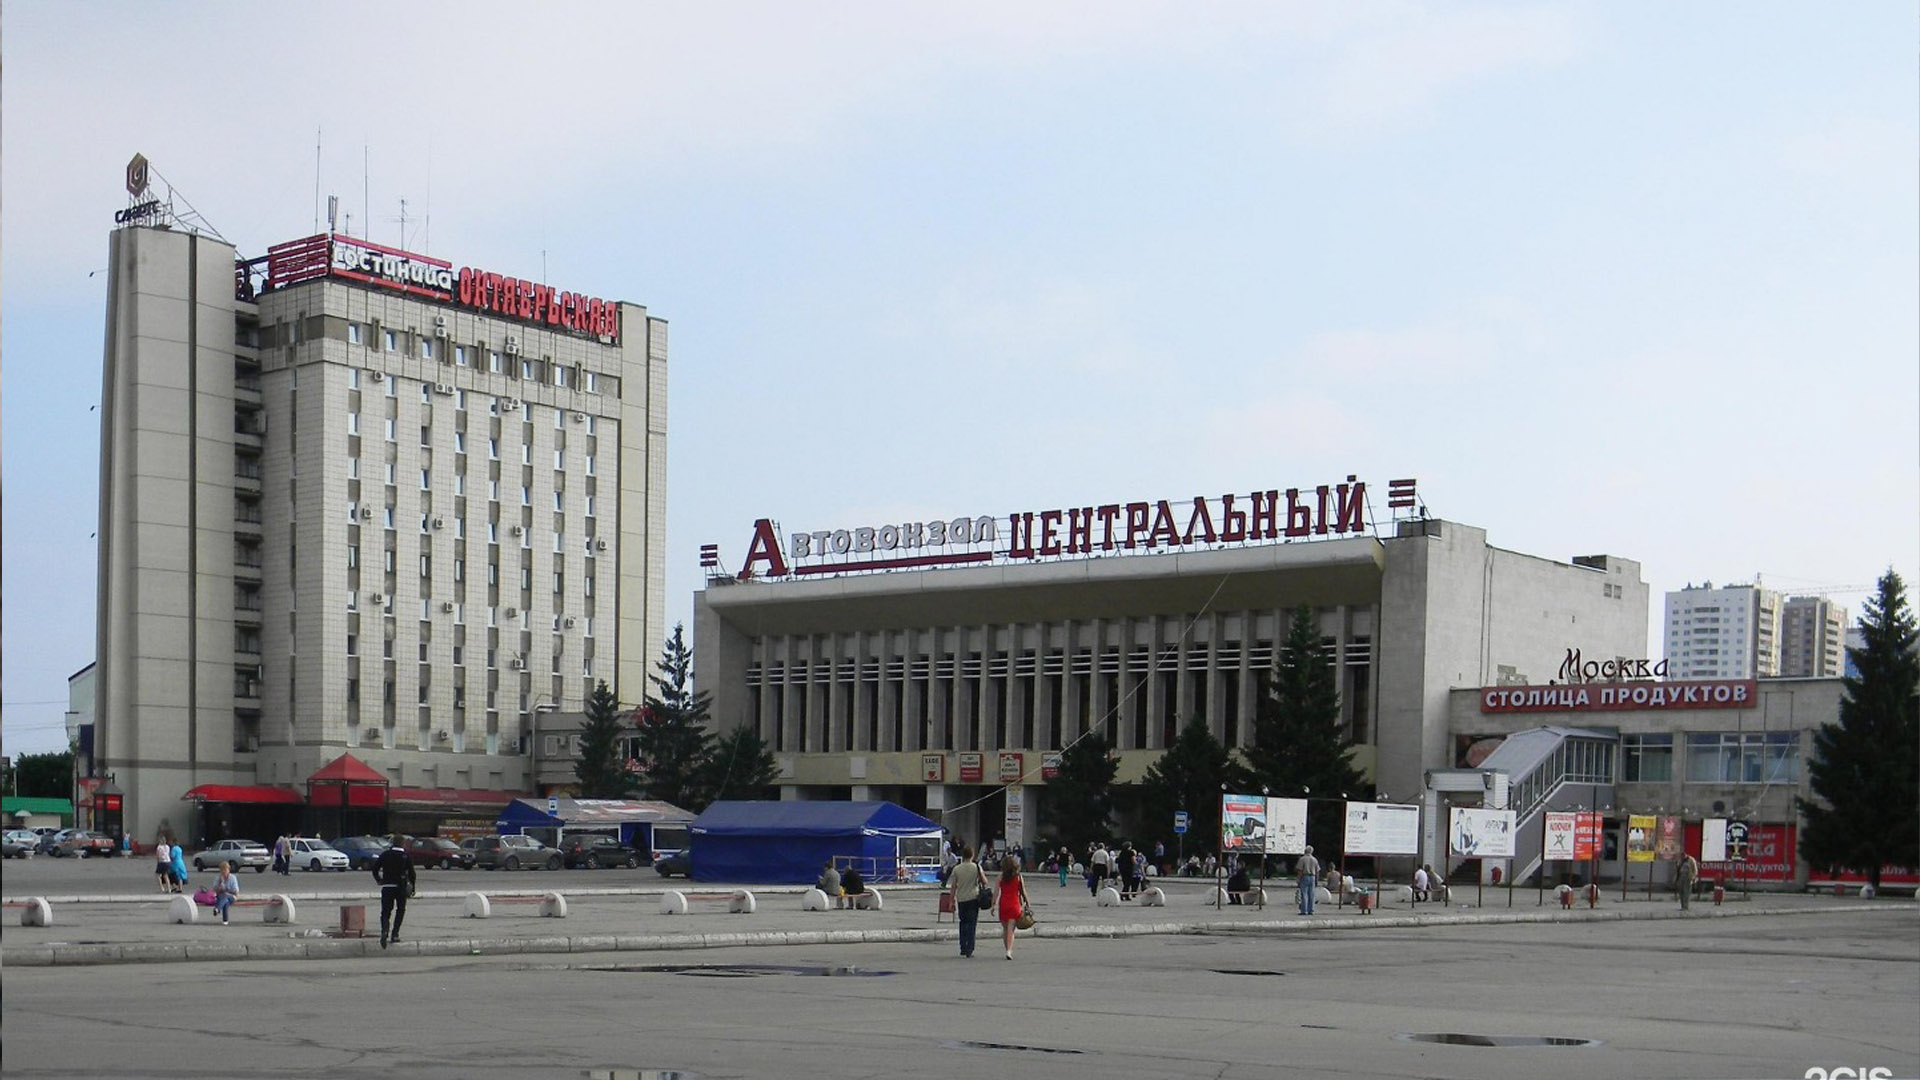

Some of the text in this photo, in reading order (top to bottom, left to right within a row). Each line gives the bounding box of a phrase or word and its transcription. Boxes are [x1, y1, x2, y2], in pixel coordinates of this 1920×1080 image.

[459, 266, 617, 338] ОКТЯБРЬСКАЯ
[1009, 475, 1366, 559] ЦЕНТРАЛЬНЫЙ
[1558, 648, 1670, 680] Москва
[1485, 684, 1749, 707] СТОЛИЦА ПРОДУКТОВ
